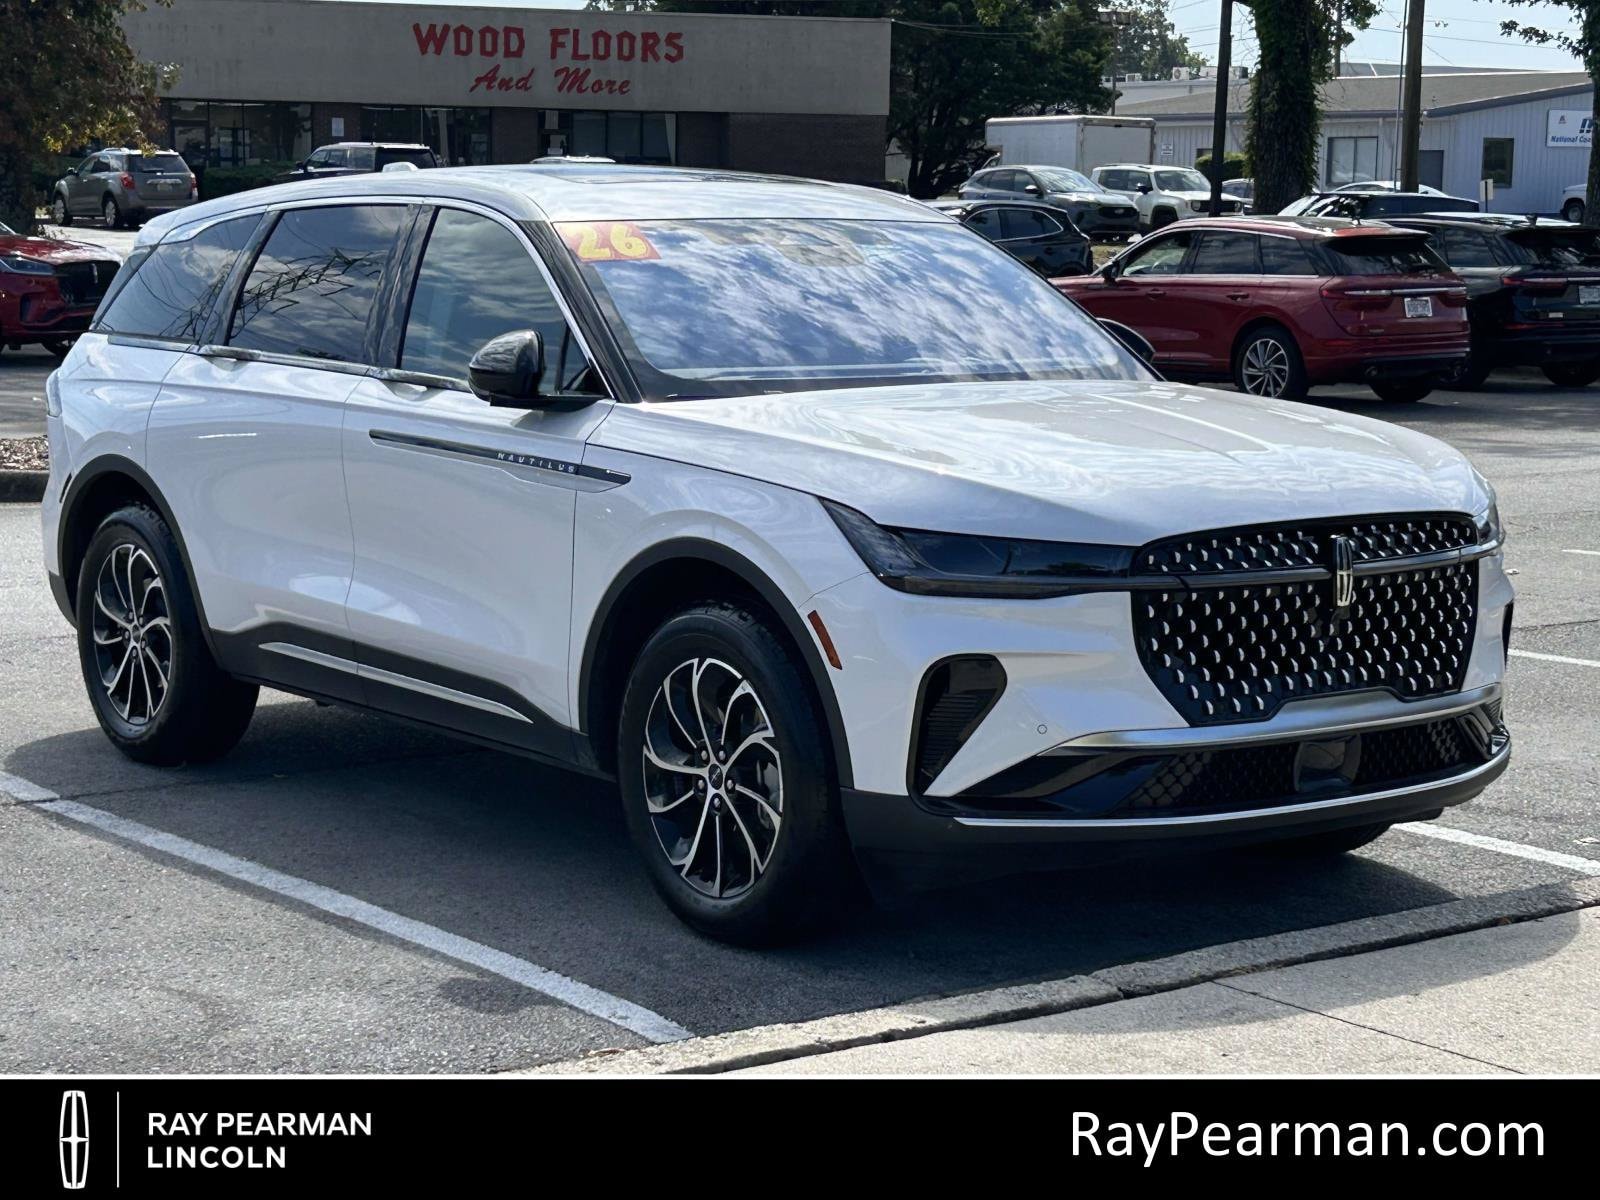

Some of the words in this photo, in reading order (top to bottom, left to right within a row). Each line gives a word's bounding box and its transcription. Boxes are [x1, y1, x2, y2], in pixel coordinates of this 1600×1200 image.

[412, 22, 526, 59] WOOD
[550, 28, 684, 63] FLOORS
[469, 64, 535, 93] And
[554, 66, 631, 95] More
[497, 452, 575, 473] NAUTILUS
